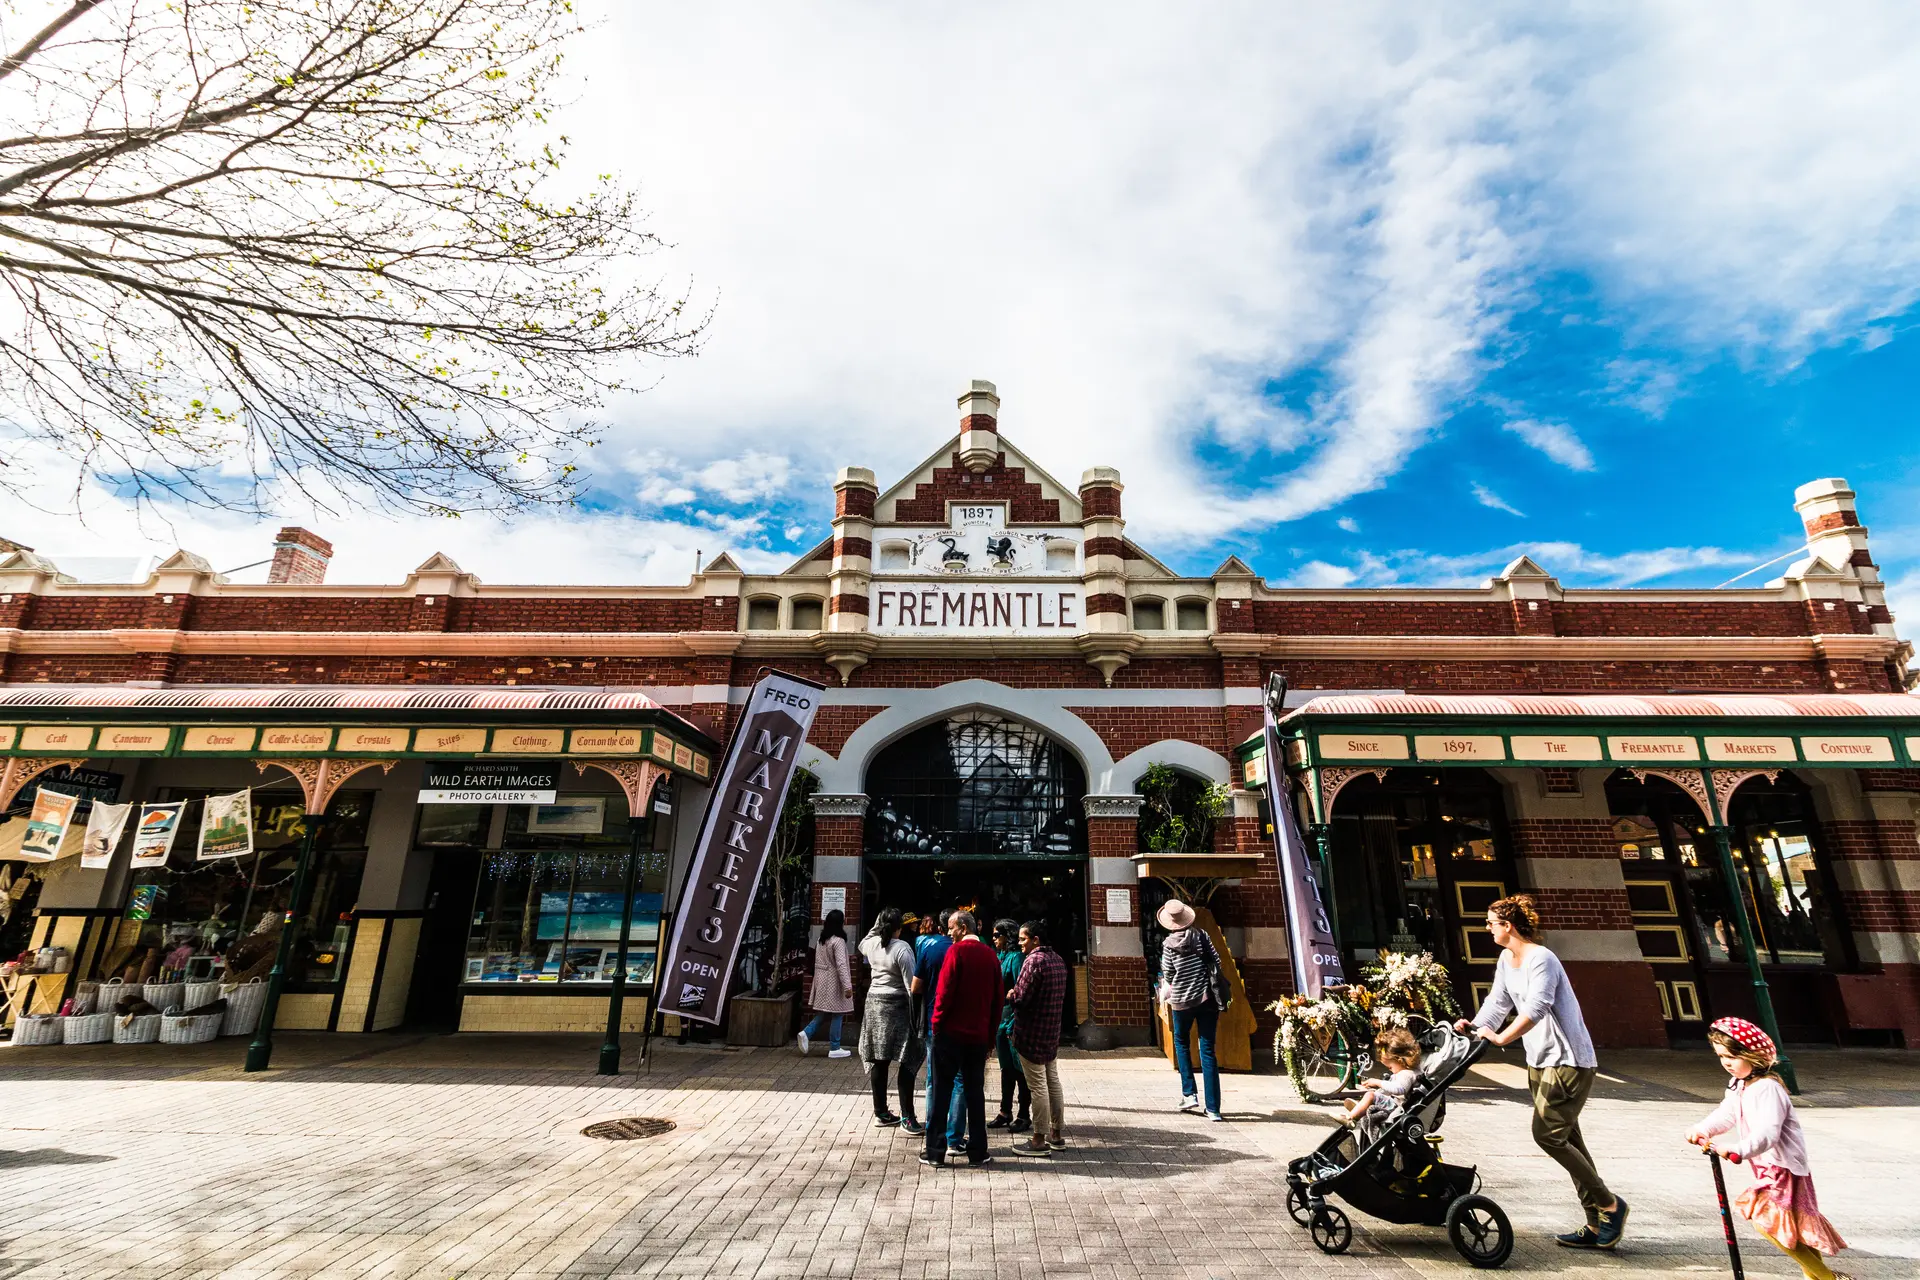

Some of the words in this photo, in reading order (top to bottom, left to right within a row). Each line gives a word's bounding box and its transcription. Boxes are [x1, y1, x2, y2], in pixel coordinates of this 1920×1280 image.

[962, 507, 994, 519] 1897
[877, 591, 1076, 628] FREMANTLE
[764, 687, 810, 710] FREO
[46, 733, 68, 743] Craft
[112, 733, 152, 744] Caneware
[206, 734, 235, 745] Cheese
[268, 734, 291, 744] Coffee
[291, 734, 300, 743] &
[356, 734, 391, 745] Crystals
[577, 736, 597, 746] Corn
[597, 738, 607, 746] on
[607, 736, 618, 746] the
[619, 736, 634, 746] Cob
[1443, 741, 1476, 754] 1897,
[1621, 742, 1685, 754] FREMANTLE
[1724, 742, 1777, 754] MARKETS
[60, 770, 109, 786] MAIZE
[429, 775, 461, 786] WILD
[464, 775, 503, 786] EARTH
[506, 775, 552, 786] IMAGES
[449, 792, 482, 801] PHOTO
[484, 792, 526, 801] GALLERY
[702, 729, 791, 944] MARKETS
[212, 841, 240, 851] PERTH
[681, 960, 719, 979] OPEN
